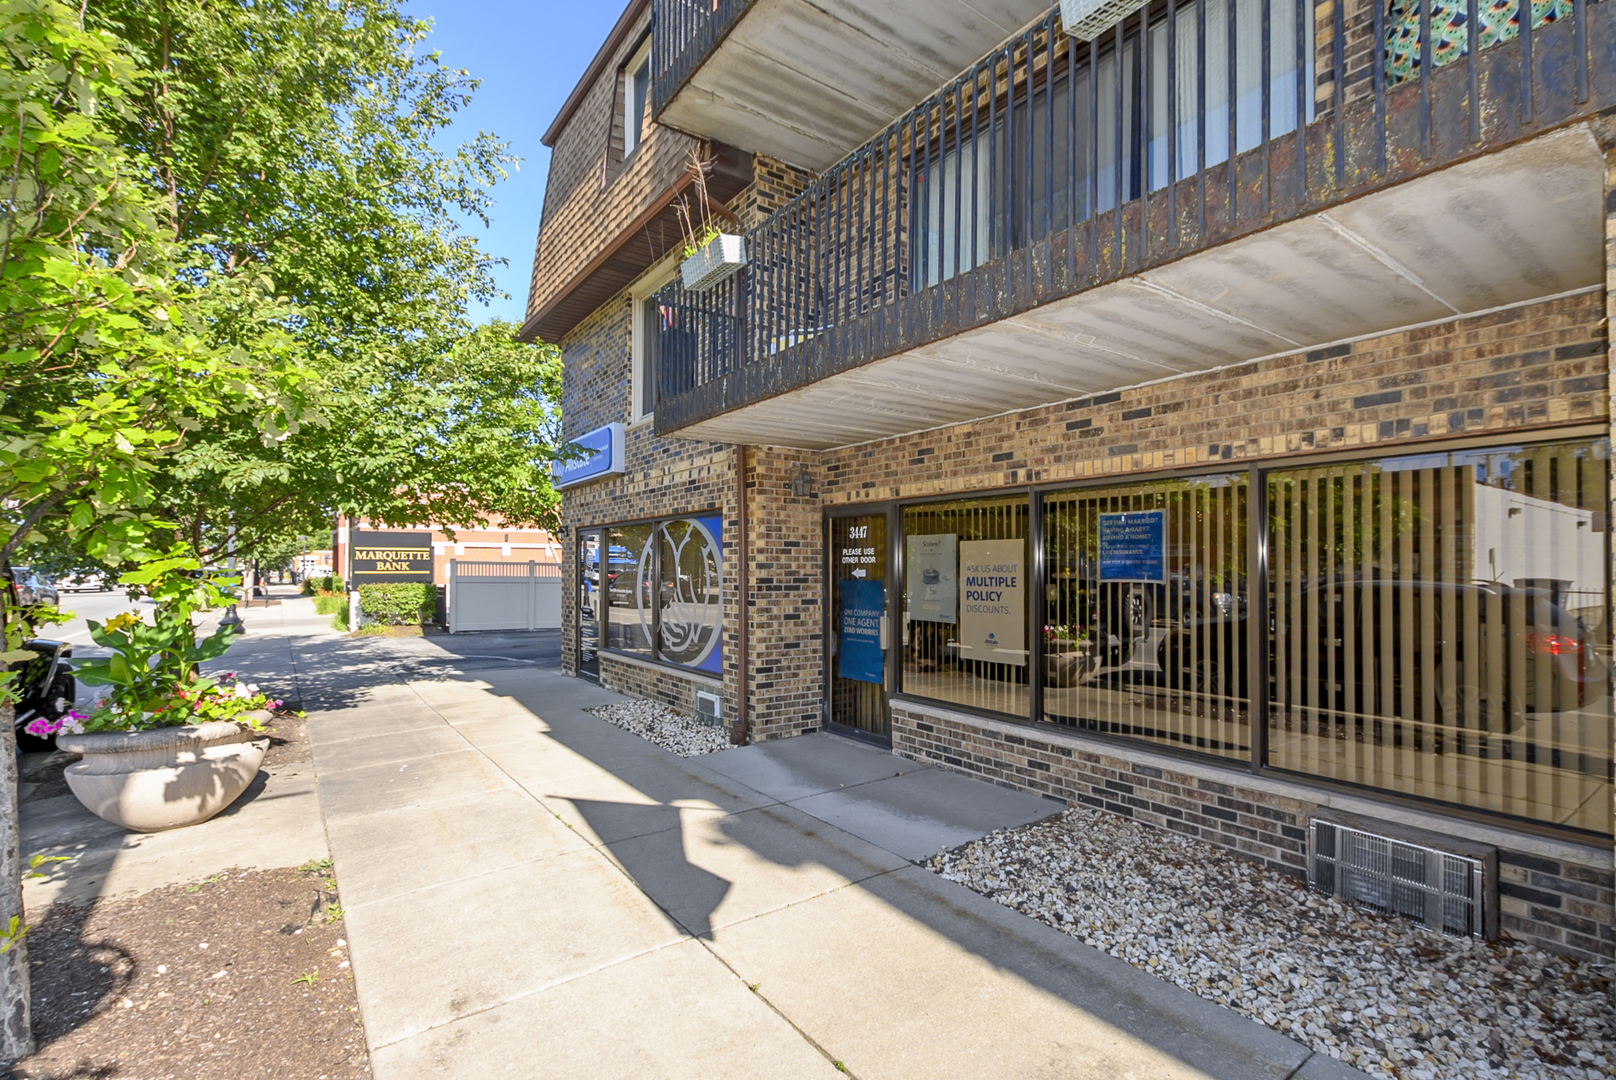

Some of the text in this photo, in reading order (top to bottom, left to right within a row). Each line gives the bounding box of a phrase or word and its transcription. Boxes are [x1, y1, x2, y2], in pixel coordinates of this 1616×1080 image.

[849, 525, 868, 539] 3447
[354, 550, 430, 562] MARQUETTE
[842, 547, 875, 556] PLEASE USE
[841, 556, 876, 564] OTHER DOOR
[376, 562, 410, 570] BANK
[966, 564, 1017, 573] ASK US ABOUT
[966, 576, 1017, 588] MULTIPLE
[966, 590, 1003, 602] POLICY
[843, 608, 853, 616] ONE
[966, 604, 1012, 615] DISCOUNTS.
[843, 616, 856, 626] ONE
[843, 626, 879, 636] ZERO WORRIES.
